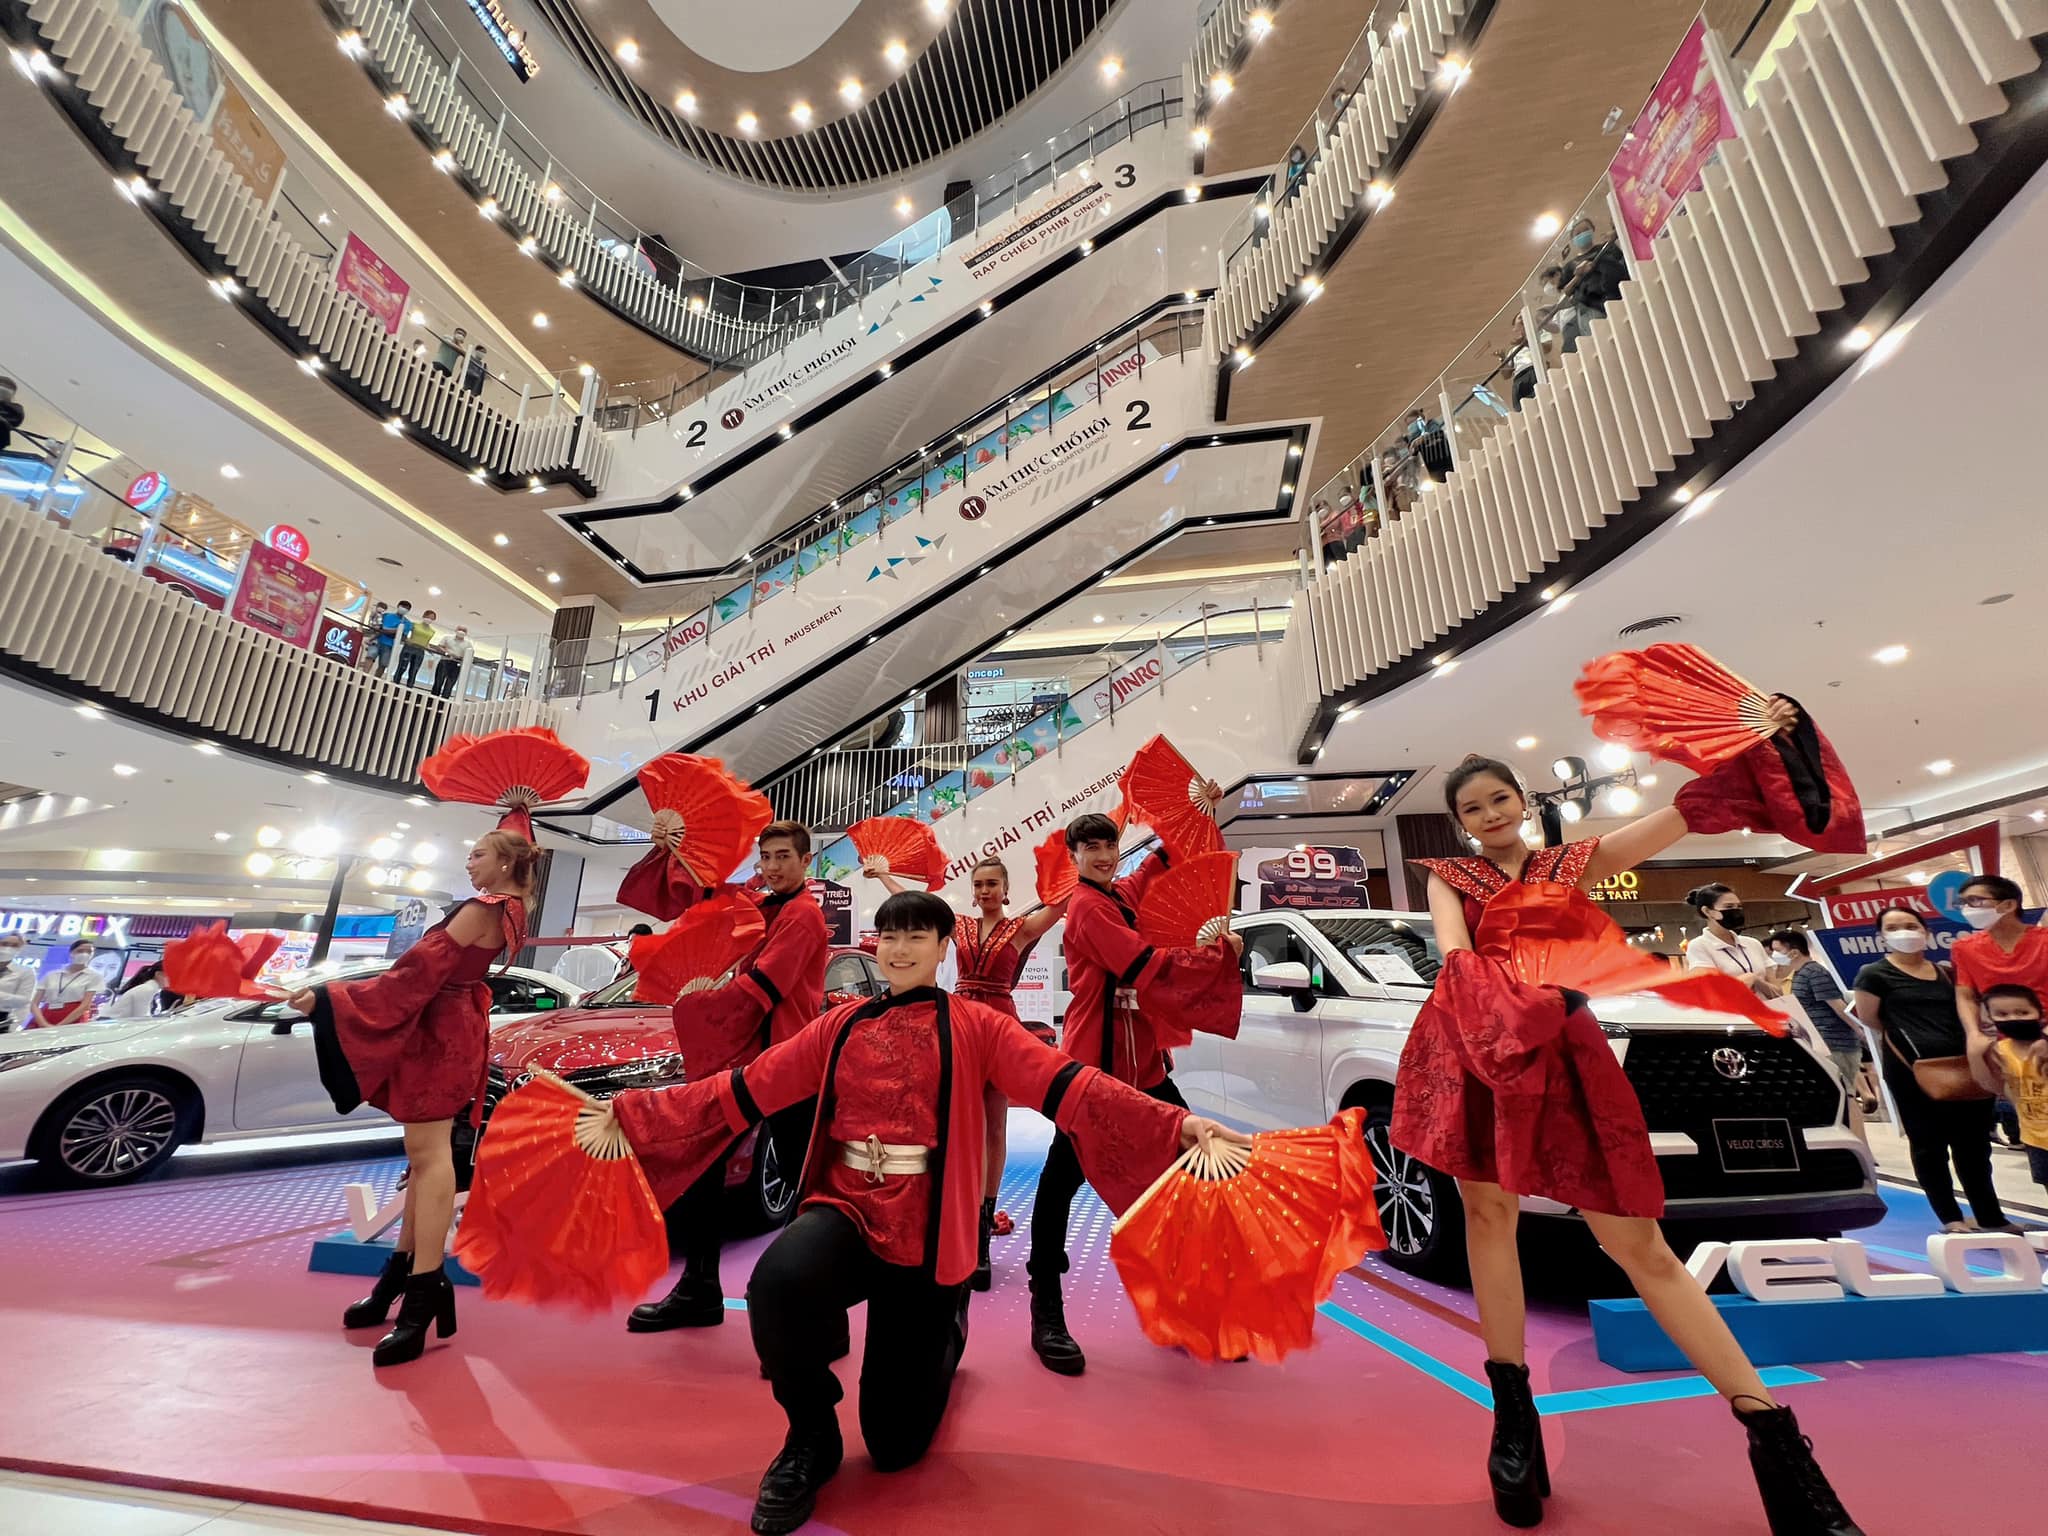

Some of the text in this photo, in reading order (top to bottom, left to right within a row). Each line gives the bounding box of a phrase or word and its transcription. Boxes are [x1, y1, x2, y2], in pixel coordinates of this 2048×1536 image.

[1114, 163, 1137, 188] 3
[1009, 225, 1031, 241] STREET
[1033, 211, 1054, 227] TASTE
[1051, 206, 1062, 216] OF
[1060, 200, 1072, 210] THE
[1070, 186, 1094, 204] WORLD
[972, 192, 1112, 280] RẠP CHIẾU PHIM CINEMA
[765, 370, 801, 397] THỰC
[803, 349, 831, 374] PHỐ
[832, 336, 857, 358] HỘI
[1126, 399, 1151, 431] 2
[685, 420, 708, 448] 2
[983, 416, 1112, 501] ẨM THỰC PHỐ HỘI
[997, 488, 1017, 502] FOOD
[1016, 475, 1038, 491] COURT
[1042, 464, 1057, 475] OLD
[1055, 446, 1086, 467] QUARTER
[1084, 432, 1108, 449] DINING
[673, 605, 843, 713] KHU GIẢI TRÍ AMUSEMENT
[968, 668, 1004, 678] oncept
[645, 689, 660, 722] 1
[982, 826, 1022, 860] GIẢI
[1022, 801, 1056, 833] TRÍ
[1060, 765, 1127, 813] AMUSEMENT
[1288, 852, 1337, 879] 99
[1269, 895, 1360, 907] VELOZ
[1607, 891, 1638, 900] TART
[1727, 1139, 1785, 1150] VELOZ CROSS
